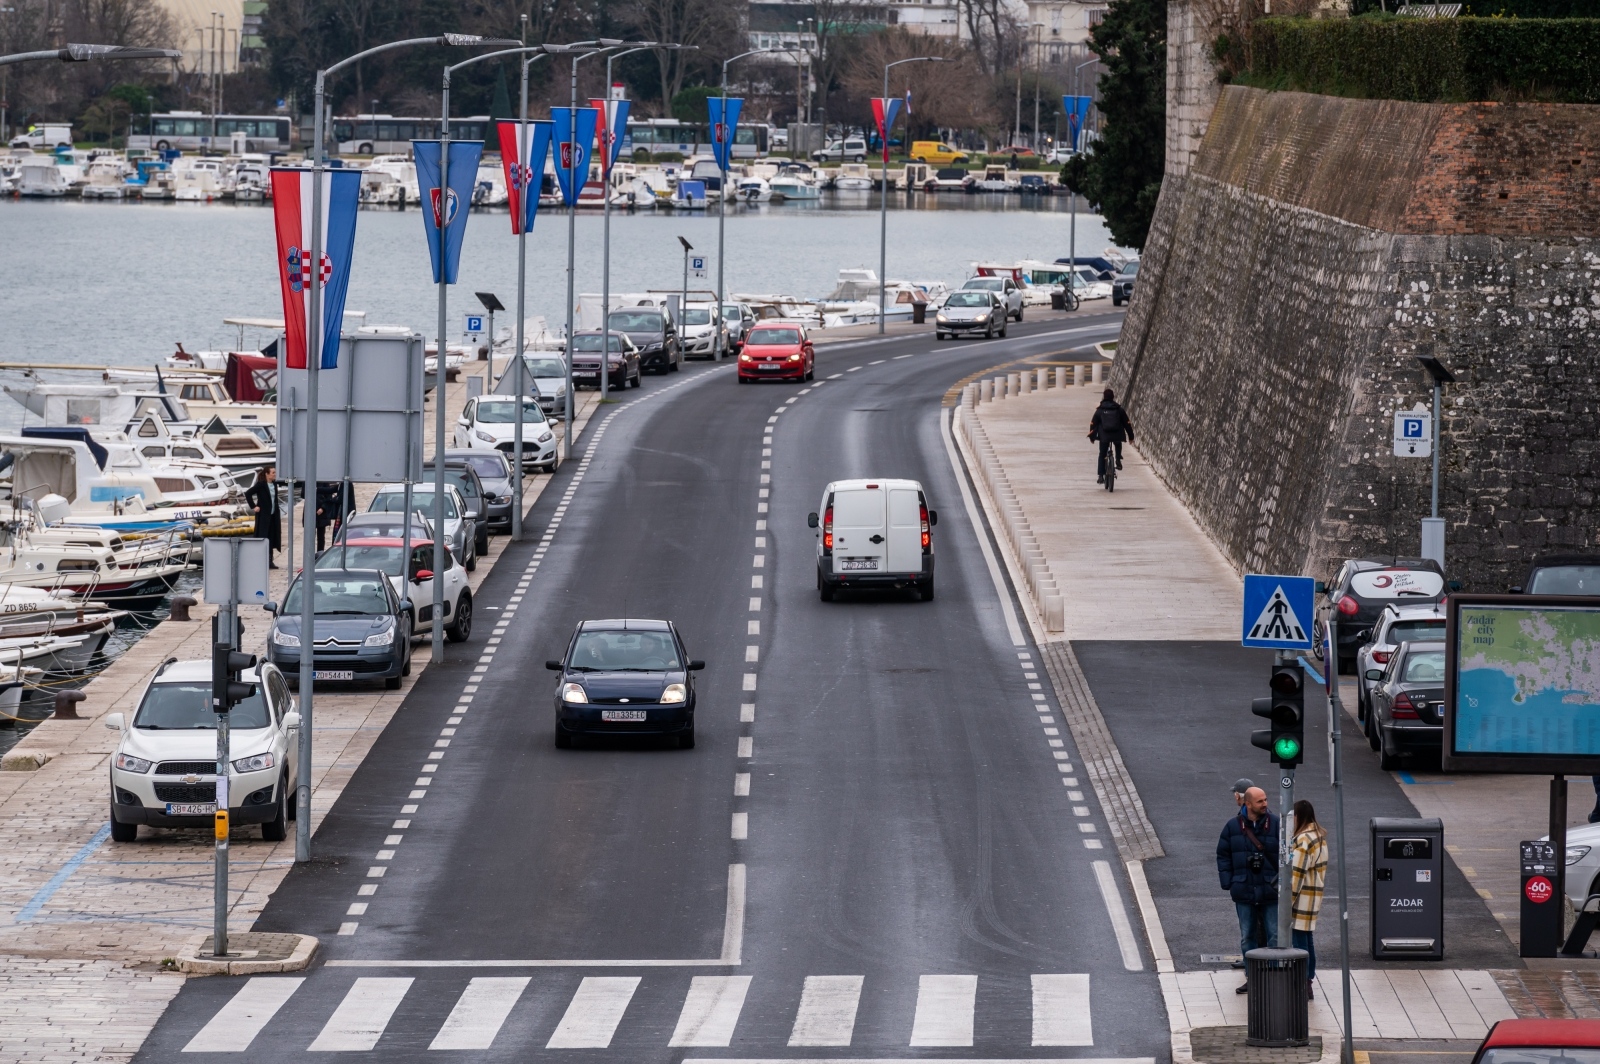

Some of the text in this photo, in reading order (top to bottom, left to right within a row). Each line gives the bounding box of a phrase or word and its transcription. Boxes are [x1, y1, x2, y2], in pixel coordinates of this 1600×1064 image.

[471, 319, 480, 330] P
[1408, 422, 1419, 436] P
[4, 602, 37, 612] ZD 8652
[1467, 615, 1495, 624] Zadar
[1477, 624, 1495, 636] city
[1473, 636, 1494, 645] map
[171, 805, 181, 813] SB
[1528, 882, 1551, 892] -60%
